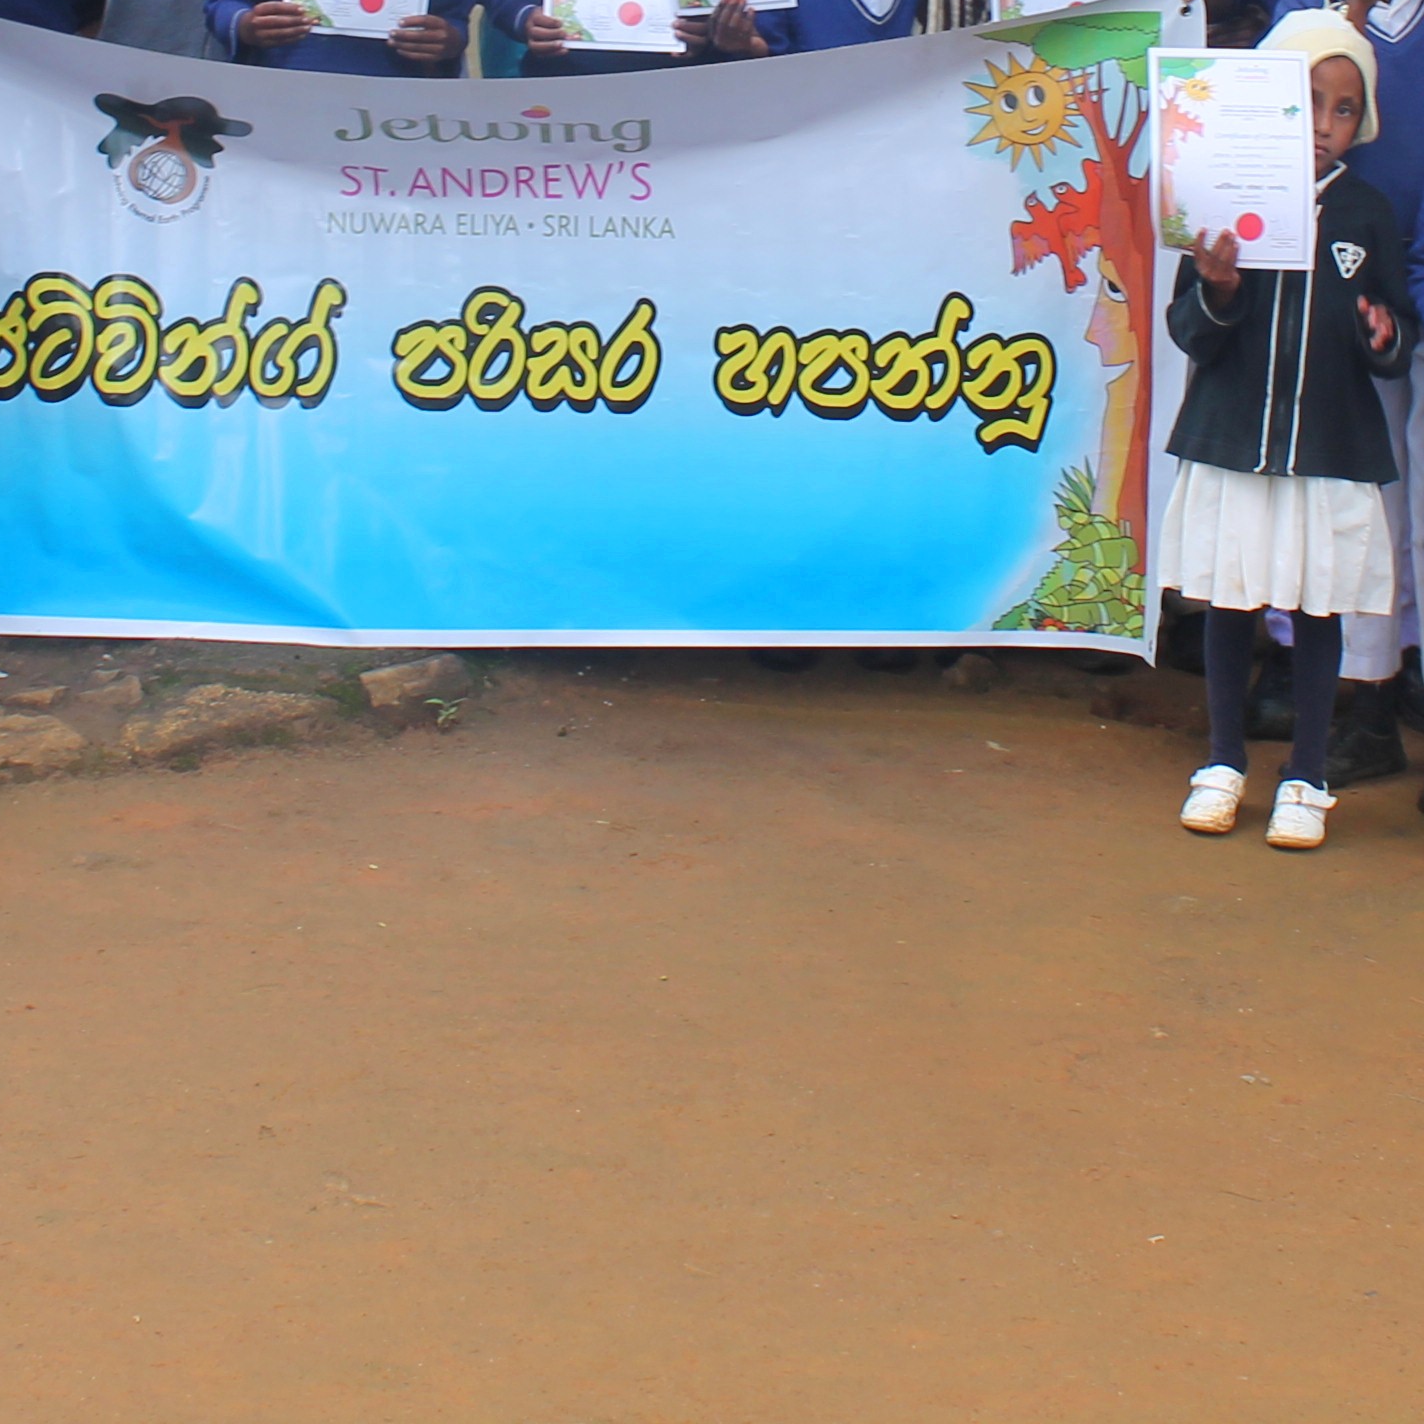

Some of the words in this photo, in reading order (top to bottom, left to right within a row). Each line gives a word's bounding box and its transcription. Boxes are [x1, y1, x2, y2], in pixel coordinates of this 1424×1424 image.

[334, 105, 652, 153] Jetwing
[339, 165, 395, 197] ST.
[407, 161, 653, 201] ANDREW'S
[326, 212, 446, 237] NUWARA
[456, 213, 520, 237] ELIYA
[542, 214, 579, 238] SRI
[588, 216, 676, 240] LANKA
[392, 286, 660, 413] පරිසර
